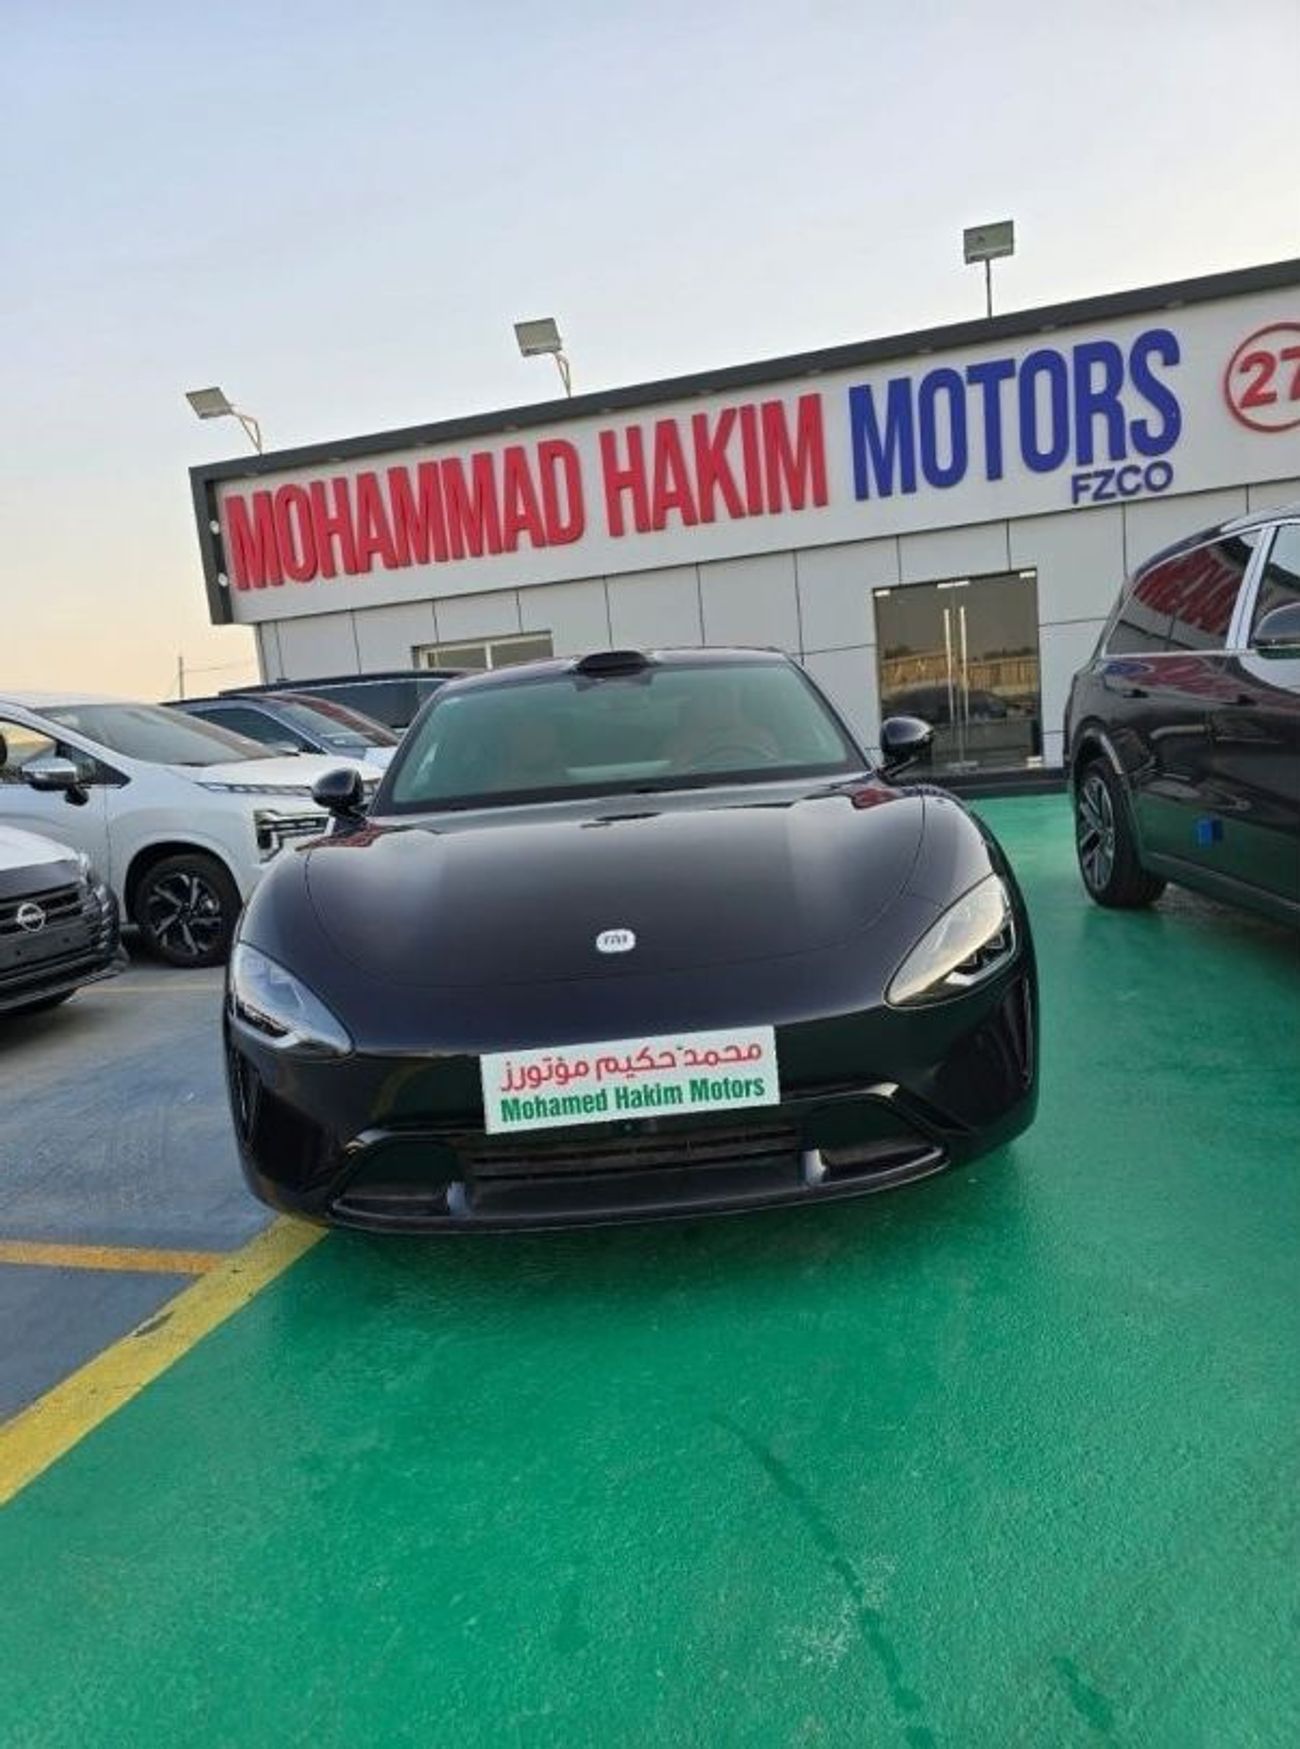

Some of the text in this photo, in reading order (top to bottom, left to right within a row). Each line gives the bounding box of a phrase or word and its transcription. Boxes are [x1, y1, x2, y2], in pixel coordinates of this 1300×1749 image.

[225, 328, 1182, 591] MOHAMMAD HAKIM MOTORS
[1071, 460, 1174, 504] FZCO
[595, 1046, 677, 1082] حكيم
[683, 1043, 763, 1067] محمد
[500, 1077, 766, 1123] Mohamed Hakim Motors
